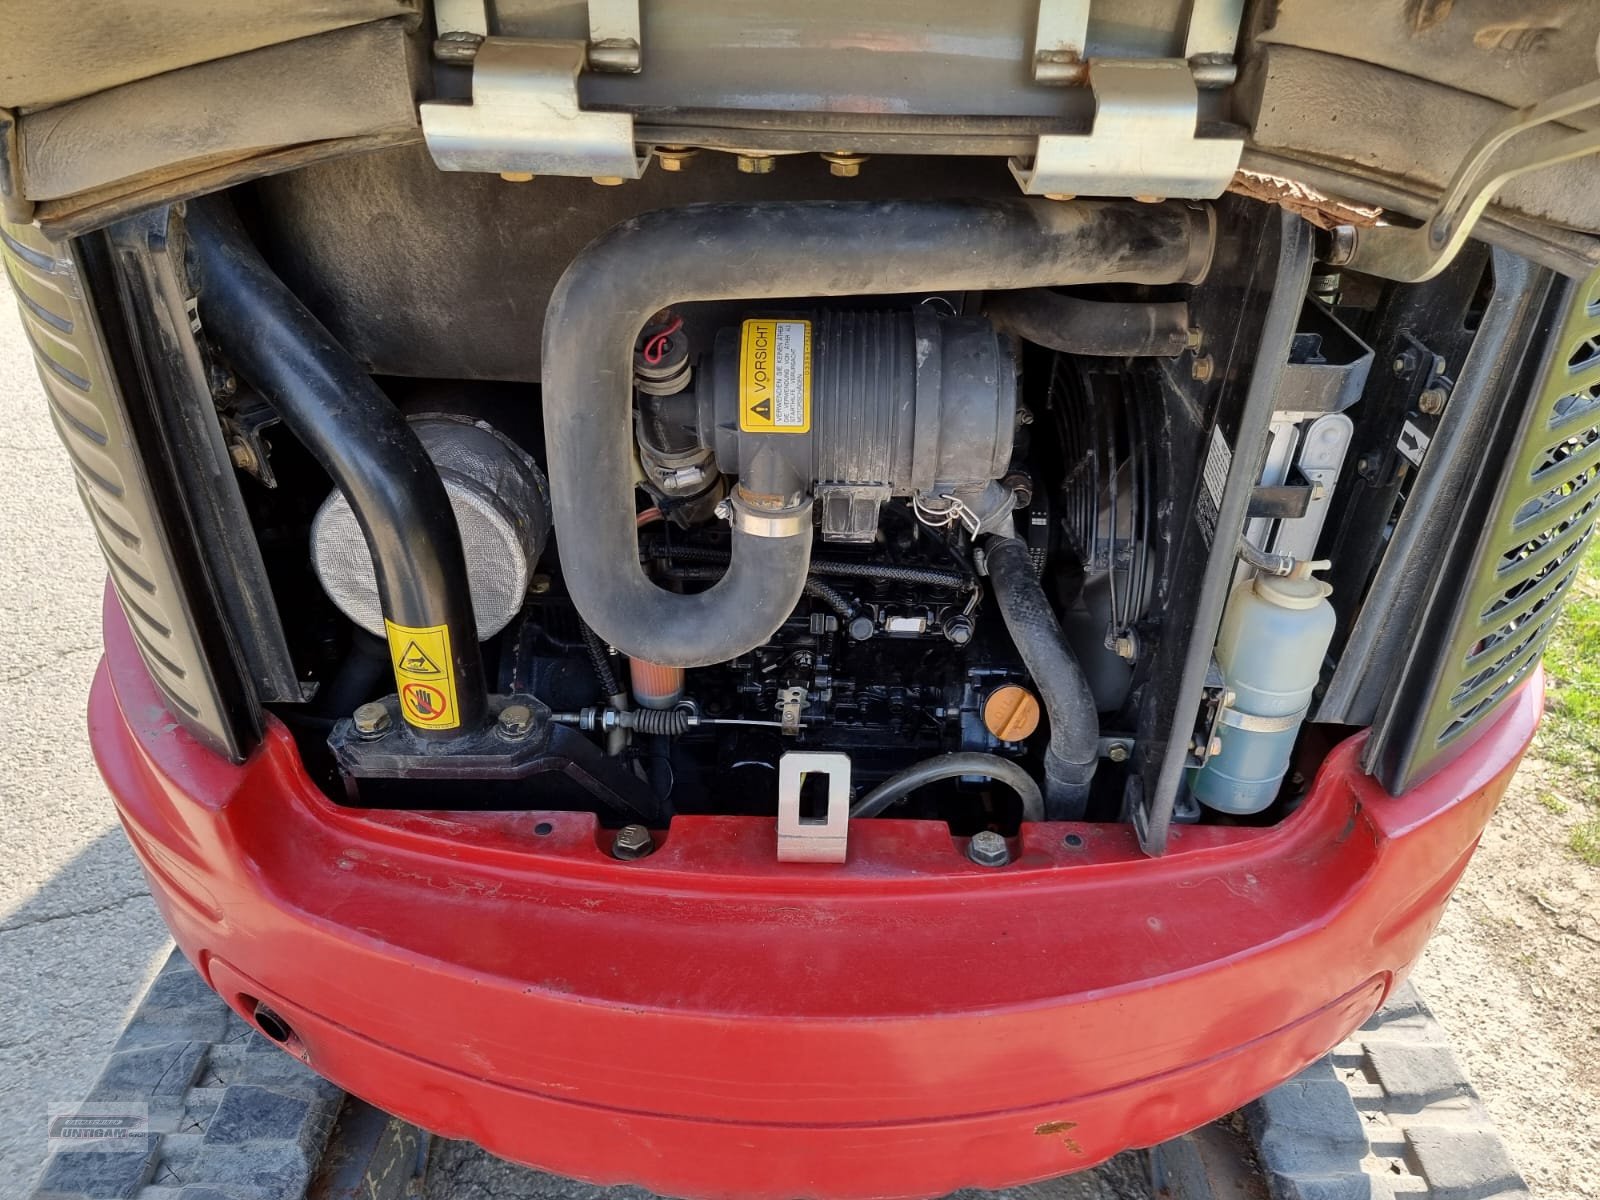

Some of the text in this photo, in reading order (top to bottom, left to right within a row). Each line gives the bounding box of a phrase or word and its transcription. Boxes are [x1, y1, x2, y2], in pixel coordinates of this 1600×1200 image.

[754, 325, 769, 393] VORSICHT
[775, 366, 783, 376] SIE
[775, 379, 783, 423] VERWENDEN
